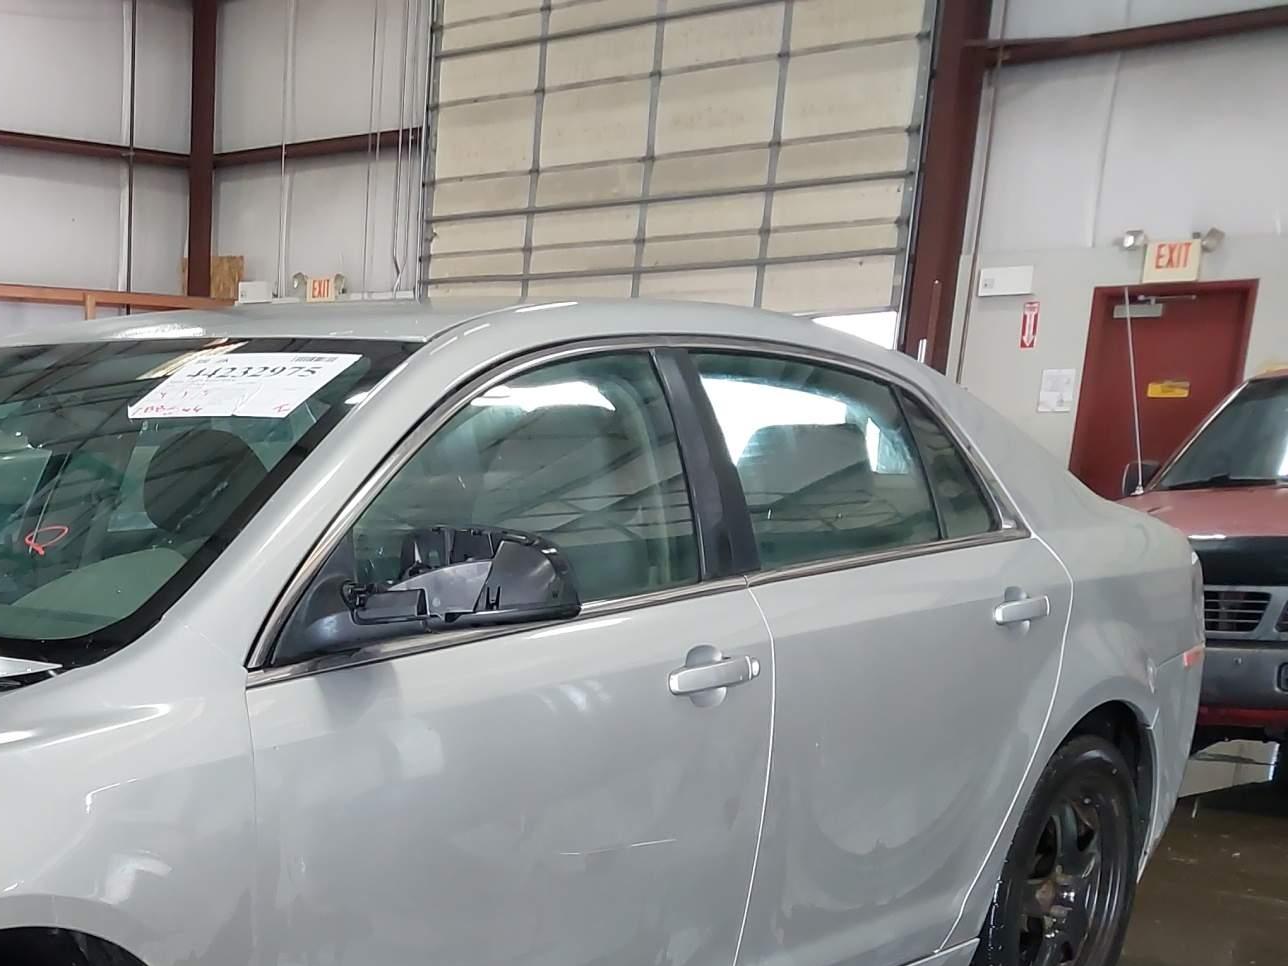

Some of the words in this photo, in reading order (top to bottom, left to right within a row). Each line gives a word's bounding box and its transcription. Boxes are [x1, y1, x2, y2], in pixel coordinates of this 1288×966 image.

[1155, 242, 1192, 269] EXIT
[312, 279, 330, 298] EXIT
[186, 366, 322, 378] 44232975
